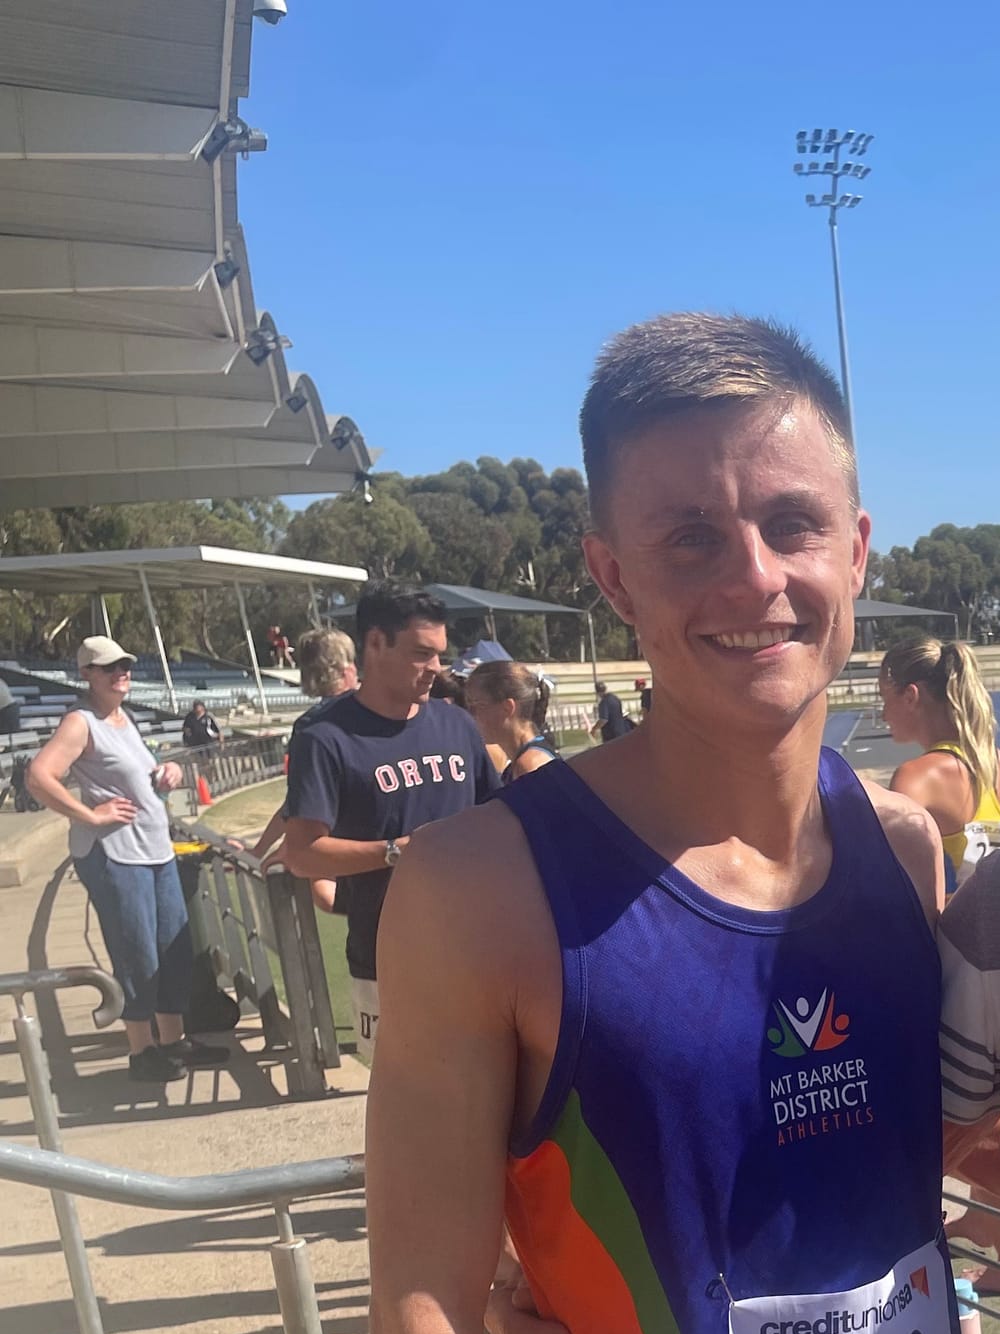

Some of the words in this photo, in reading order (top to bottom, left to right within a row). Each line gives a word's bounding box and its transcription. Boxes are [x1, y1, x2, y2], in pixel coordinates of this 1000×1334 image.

[375, 754, 466, 793] ORTC
[769, 1074, 792, 1099] MT
[797, 1058, 867, 1090] BARKER
[773, 1080, 869, 1125] DISTRICT
[777, 1106, 874, 1147] ATHLETICS
